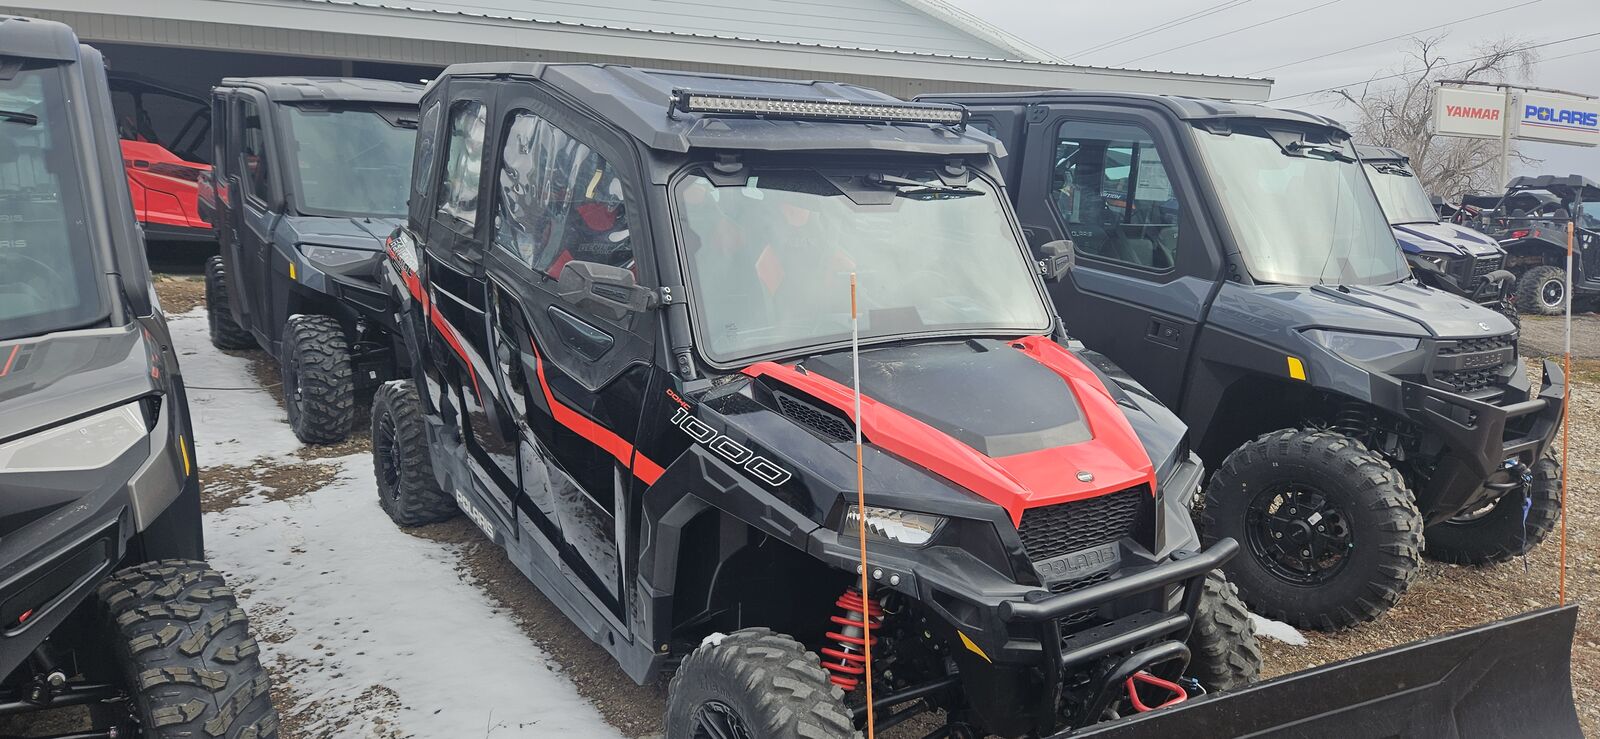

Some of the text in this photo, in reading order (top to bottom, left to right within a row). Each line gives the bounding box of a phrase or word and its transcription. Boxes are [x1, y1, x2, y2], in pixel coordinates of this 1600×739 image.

[1447, 105, 1500, 121] YANMAR
[1525, 104, 1597, 126] POLARIS
[666, 388, 691, 410] DOHC
[670, 407, 792, 487] 1000
[456, 489, 494, 539] POLARIS
[1039, 546, 1116, 578] POLARIS
